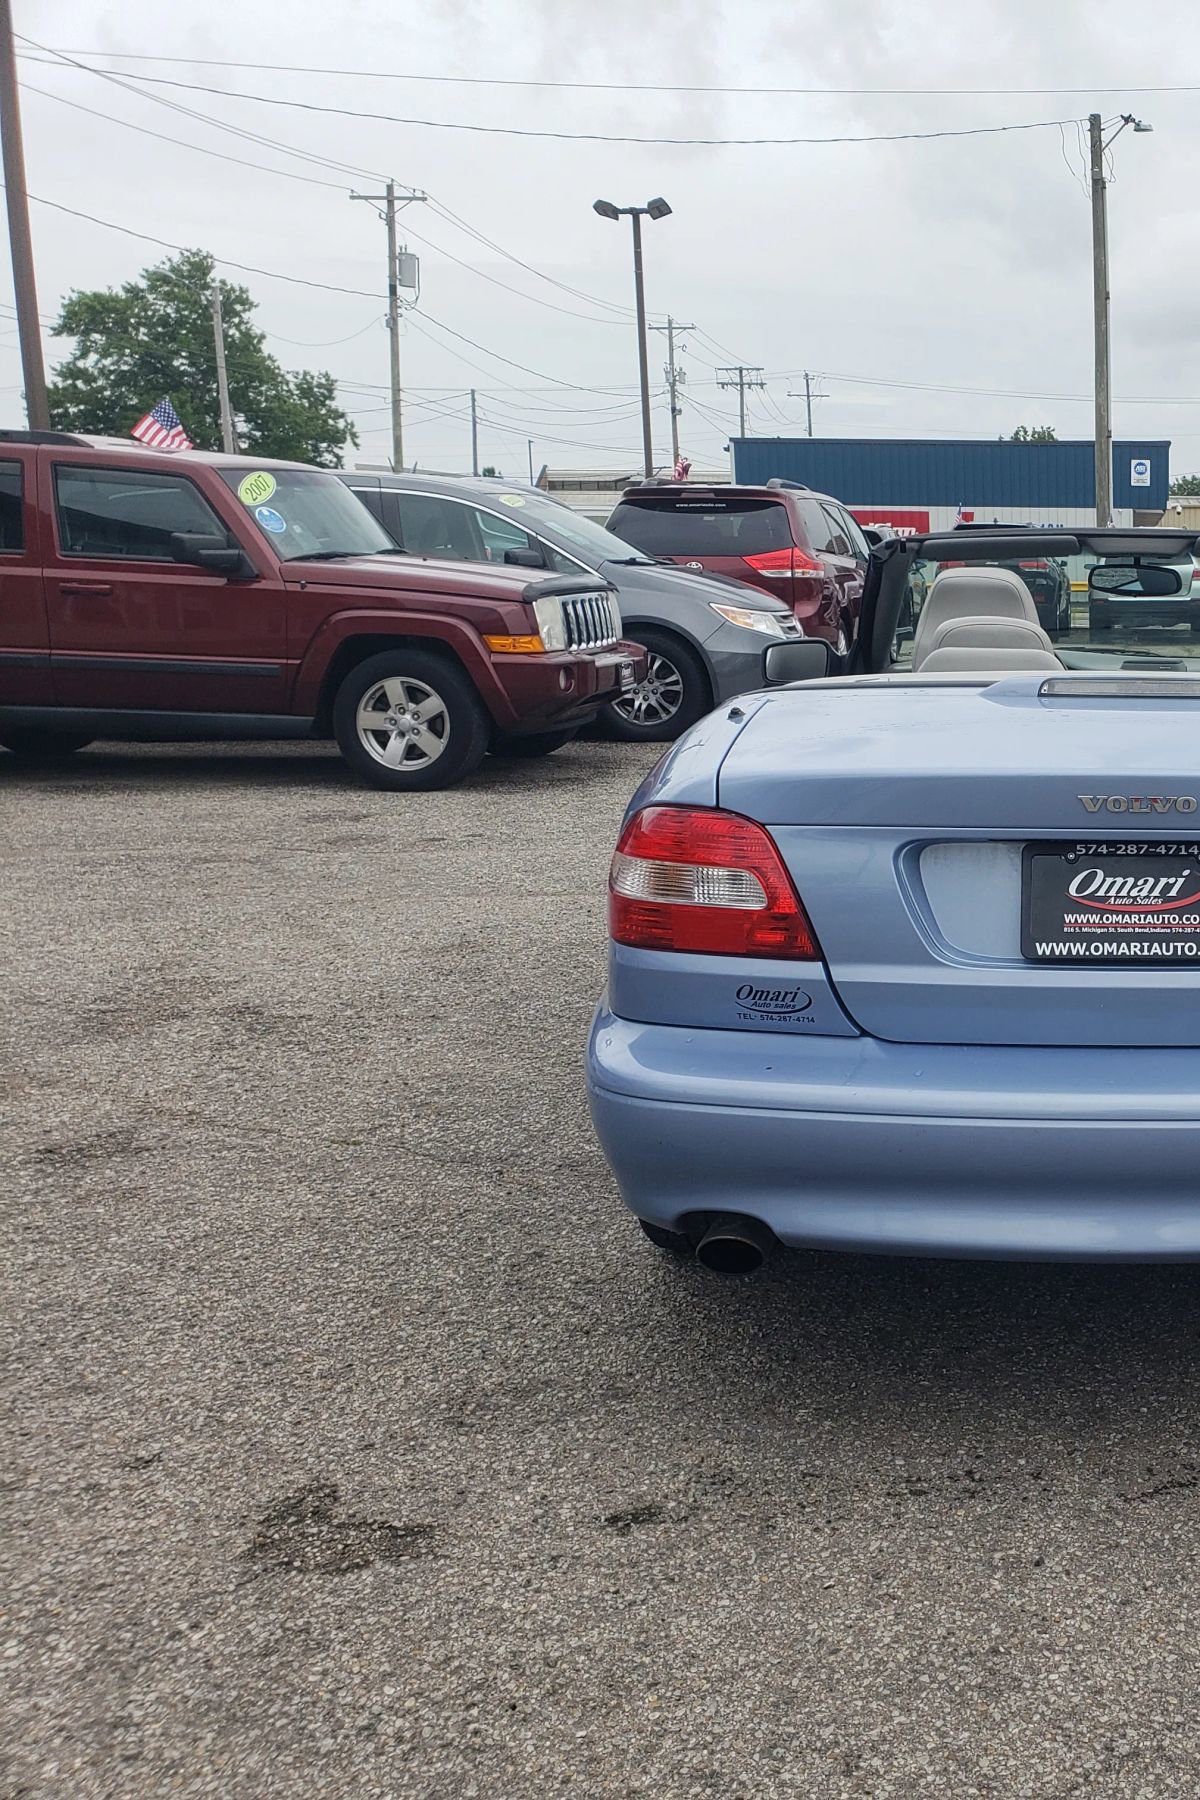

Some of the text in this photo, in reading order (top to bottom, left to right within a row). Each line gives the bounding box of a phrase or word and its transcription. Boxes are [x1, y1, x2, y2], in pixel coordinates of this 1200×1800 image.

[245, 474, 270, 502] 2007
[1077, 795, 1198, 814] VOLVO
[1076, 844, 1199, 855] 574-287-4714
[1068, 868, 1191, 897] Omari
[1105, 896, 1163, 905] Auto Sales
[736, 984, 801, 1003] Omari
[751, 1001, 771, 1009] Auto
[760, 1014, 816, 1023] 574-287-4714
